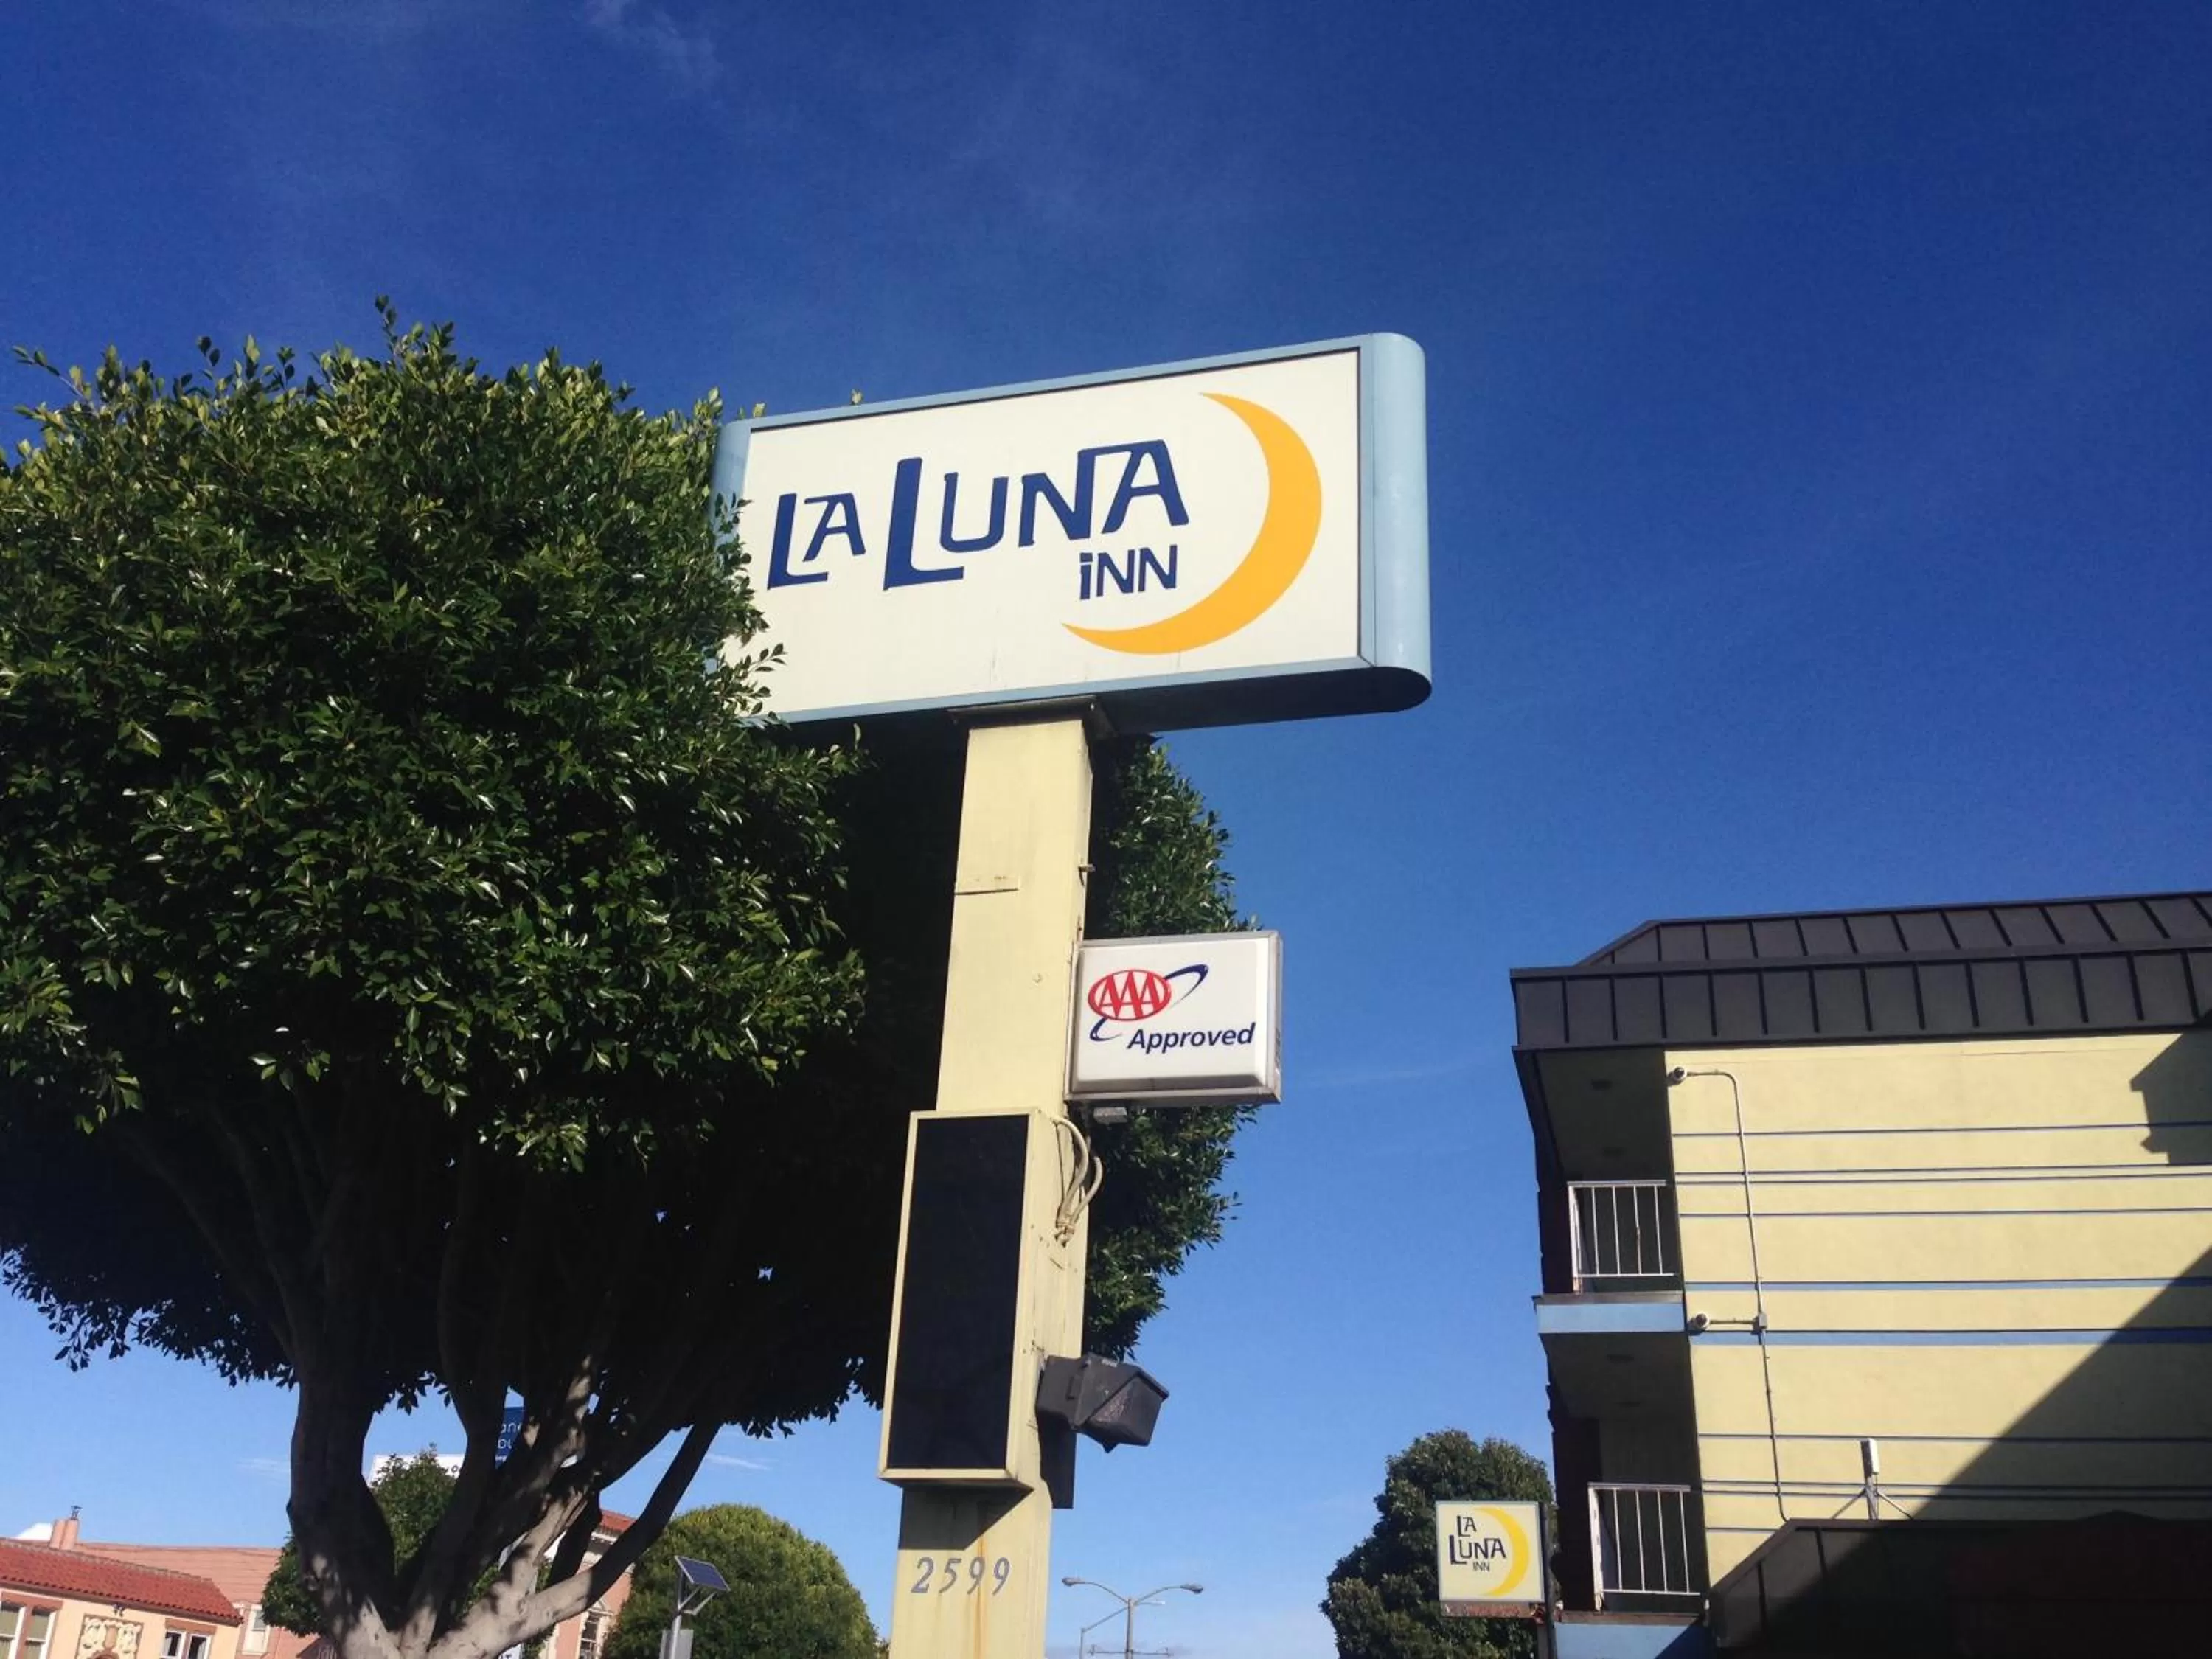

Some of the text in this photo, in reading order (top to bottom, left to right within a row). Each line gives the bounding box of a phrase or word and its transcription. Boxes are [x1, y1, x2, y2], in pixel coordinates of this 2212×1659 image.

[766, 439, 1189, 591] LA LUNA
[1094, 970, 1164, 1020] AAA
[1126, 1022, 1256, 1055] Approved
[1456, 1515, 1477, 1537] LA
[1449, 1534, 1506, 1565] LUNA
[1472, 1561, 1490, 1571] INN
[911, 1556, 1010, 1596] 2599
